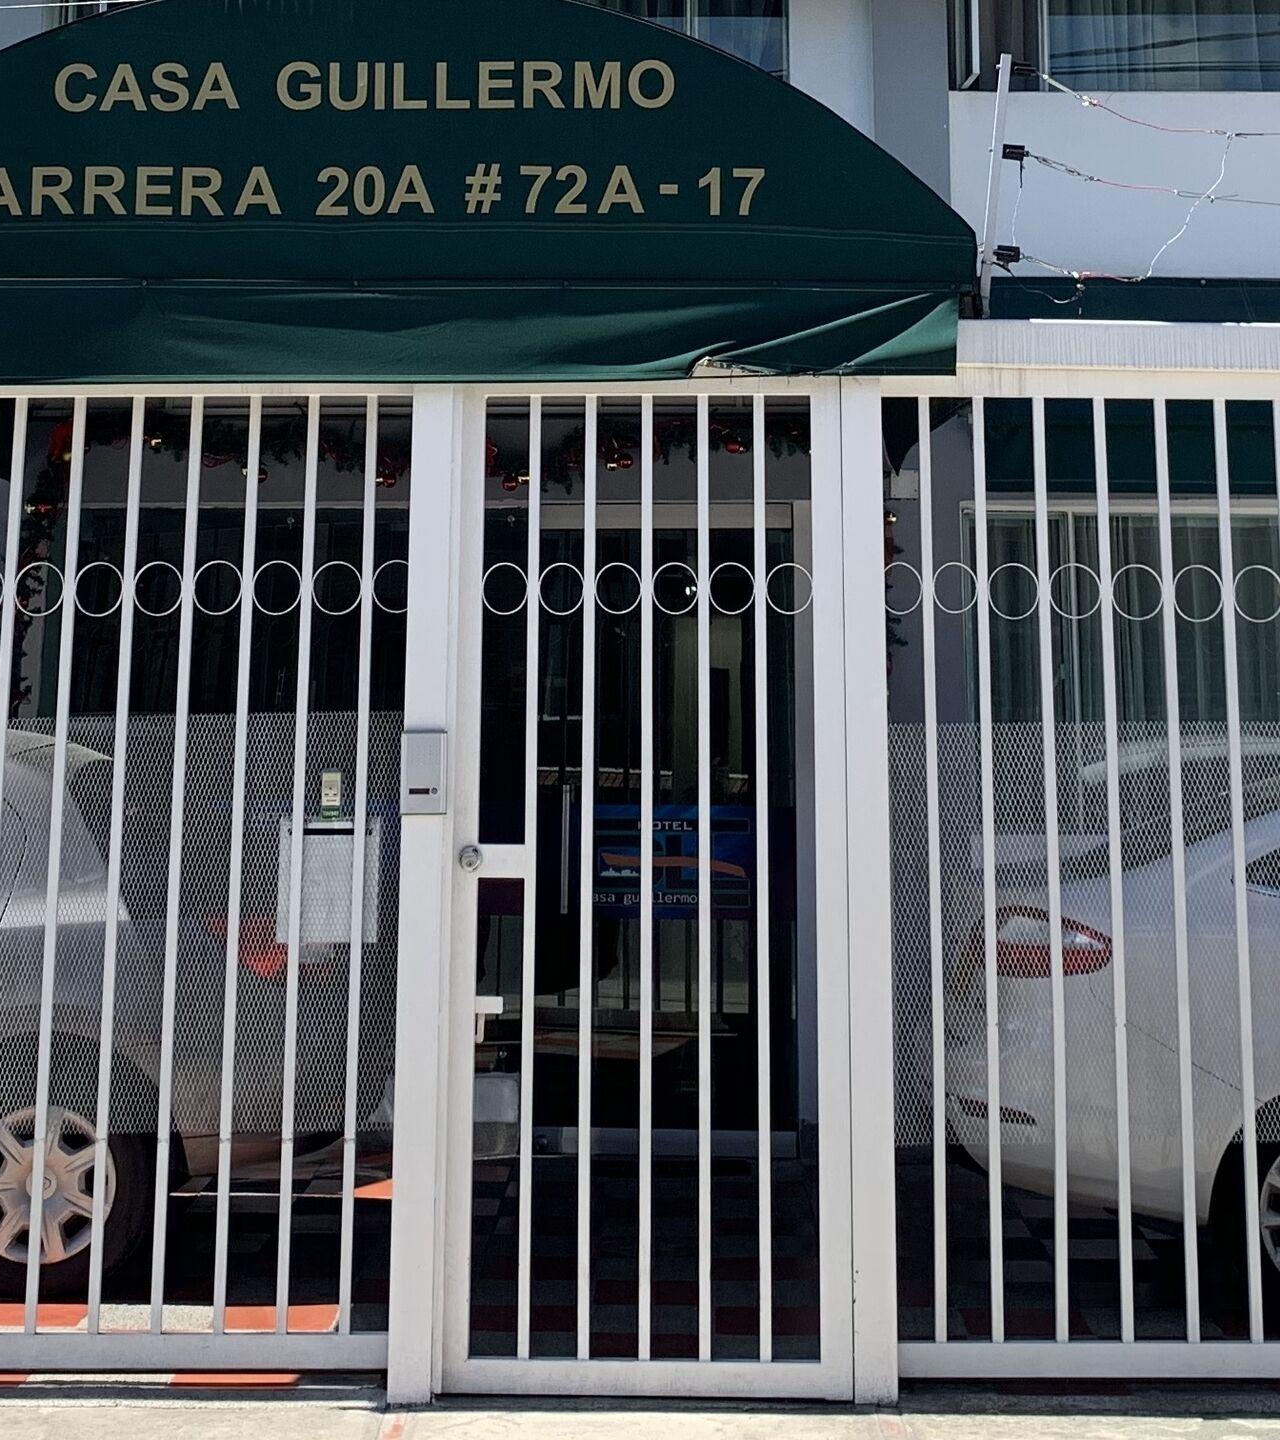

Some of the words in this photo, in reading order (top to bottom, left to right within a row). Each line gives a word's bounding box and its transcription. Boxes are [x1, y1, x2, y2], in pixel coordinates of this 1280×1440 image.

[54, 62, 241, 113] CASA
[276, 59, 675, 111] GUILLERMO
[316, 164, 435, 216] 20A
[593, 893, 615, 902] asa
[624, 892, 697, 905] gulermo
